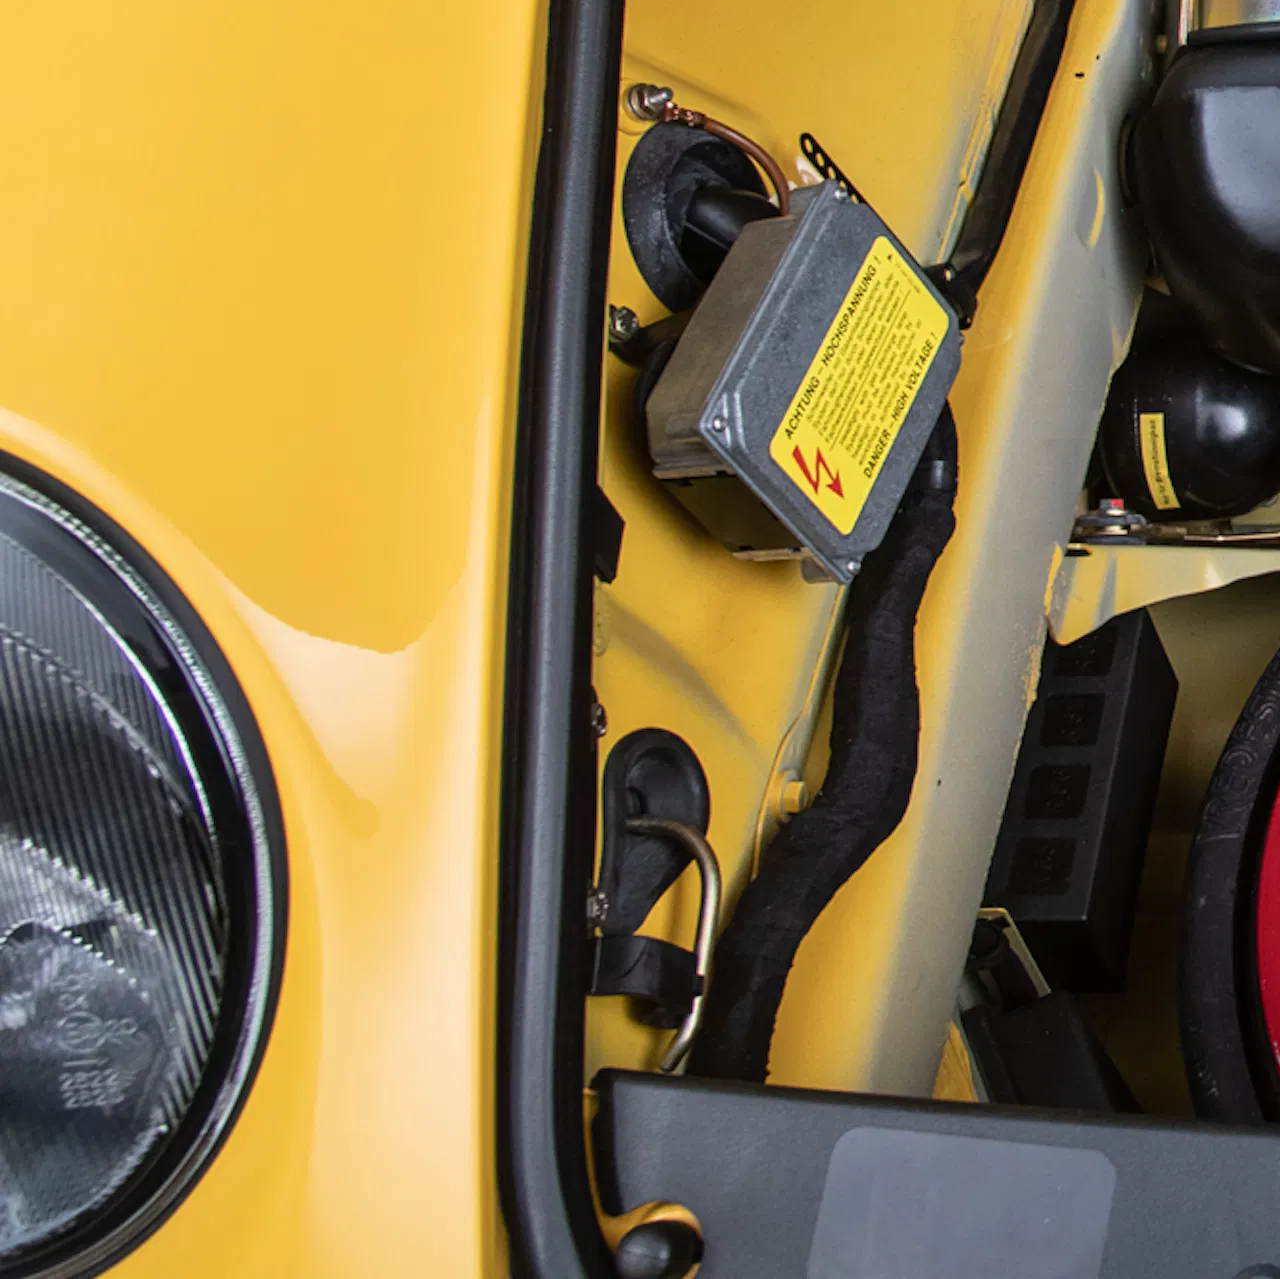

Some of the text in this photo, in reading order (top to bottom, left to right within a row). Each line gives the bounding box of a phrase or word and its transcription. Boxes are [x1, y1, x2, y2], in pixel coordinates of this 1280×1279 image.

[786, 377, 820, 439] ACHTUNG
[823, 265, 876, 364] HOCHSPANNUNG
[865, 430, 891, 478] DANGER
[891, 391, 909, 421] HIGH
[906, 341, 933, 391] VOLTAGE
